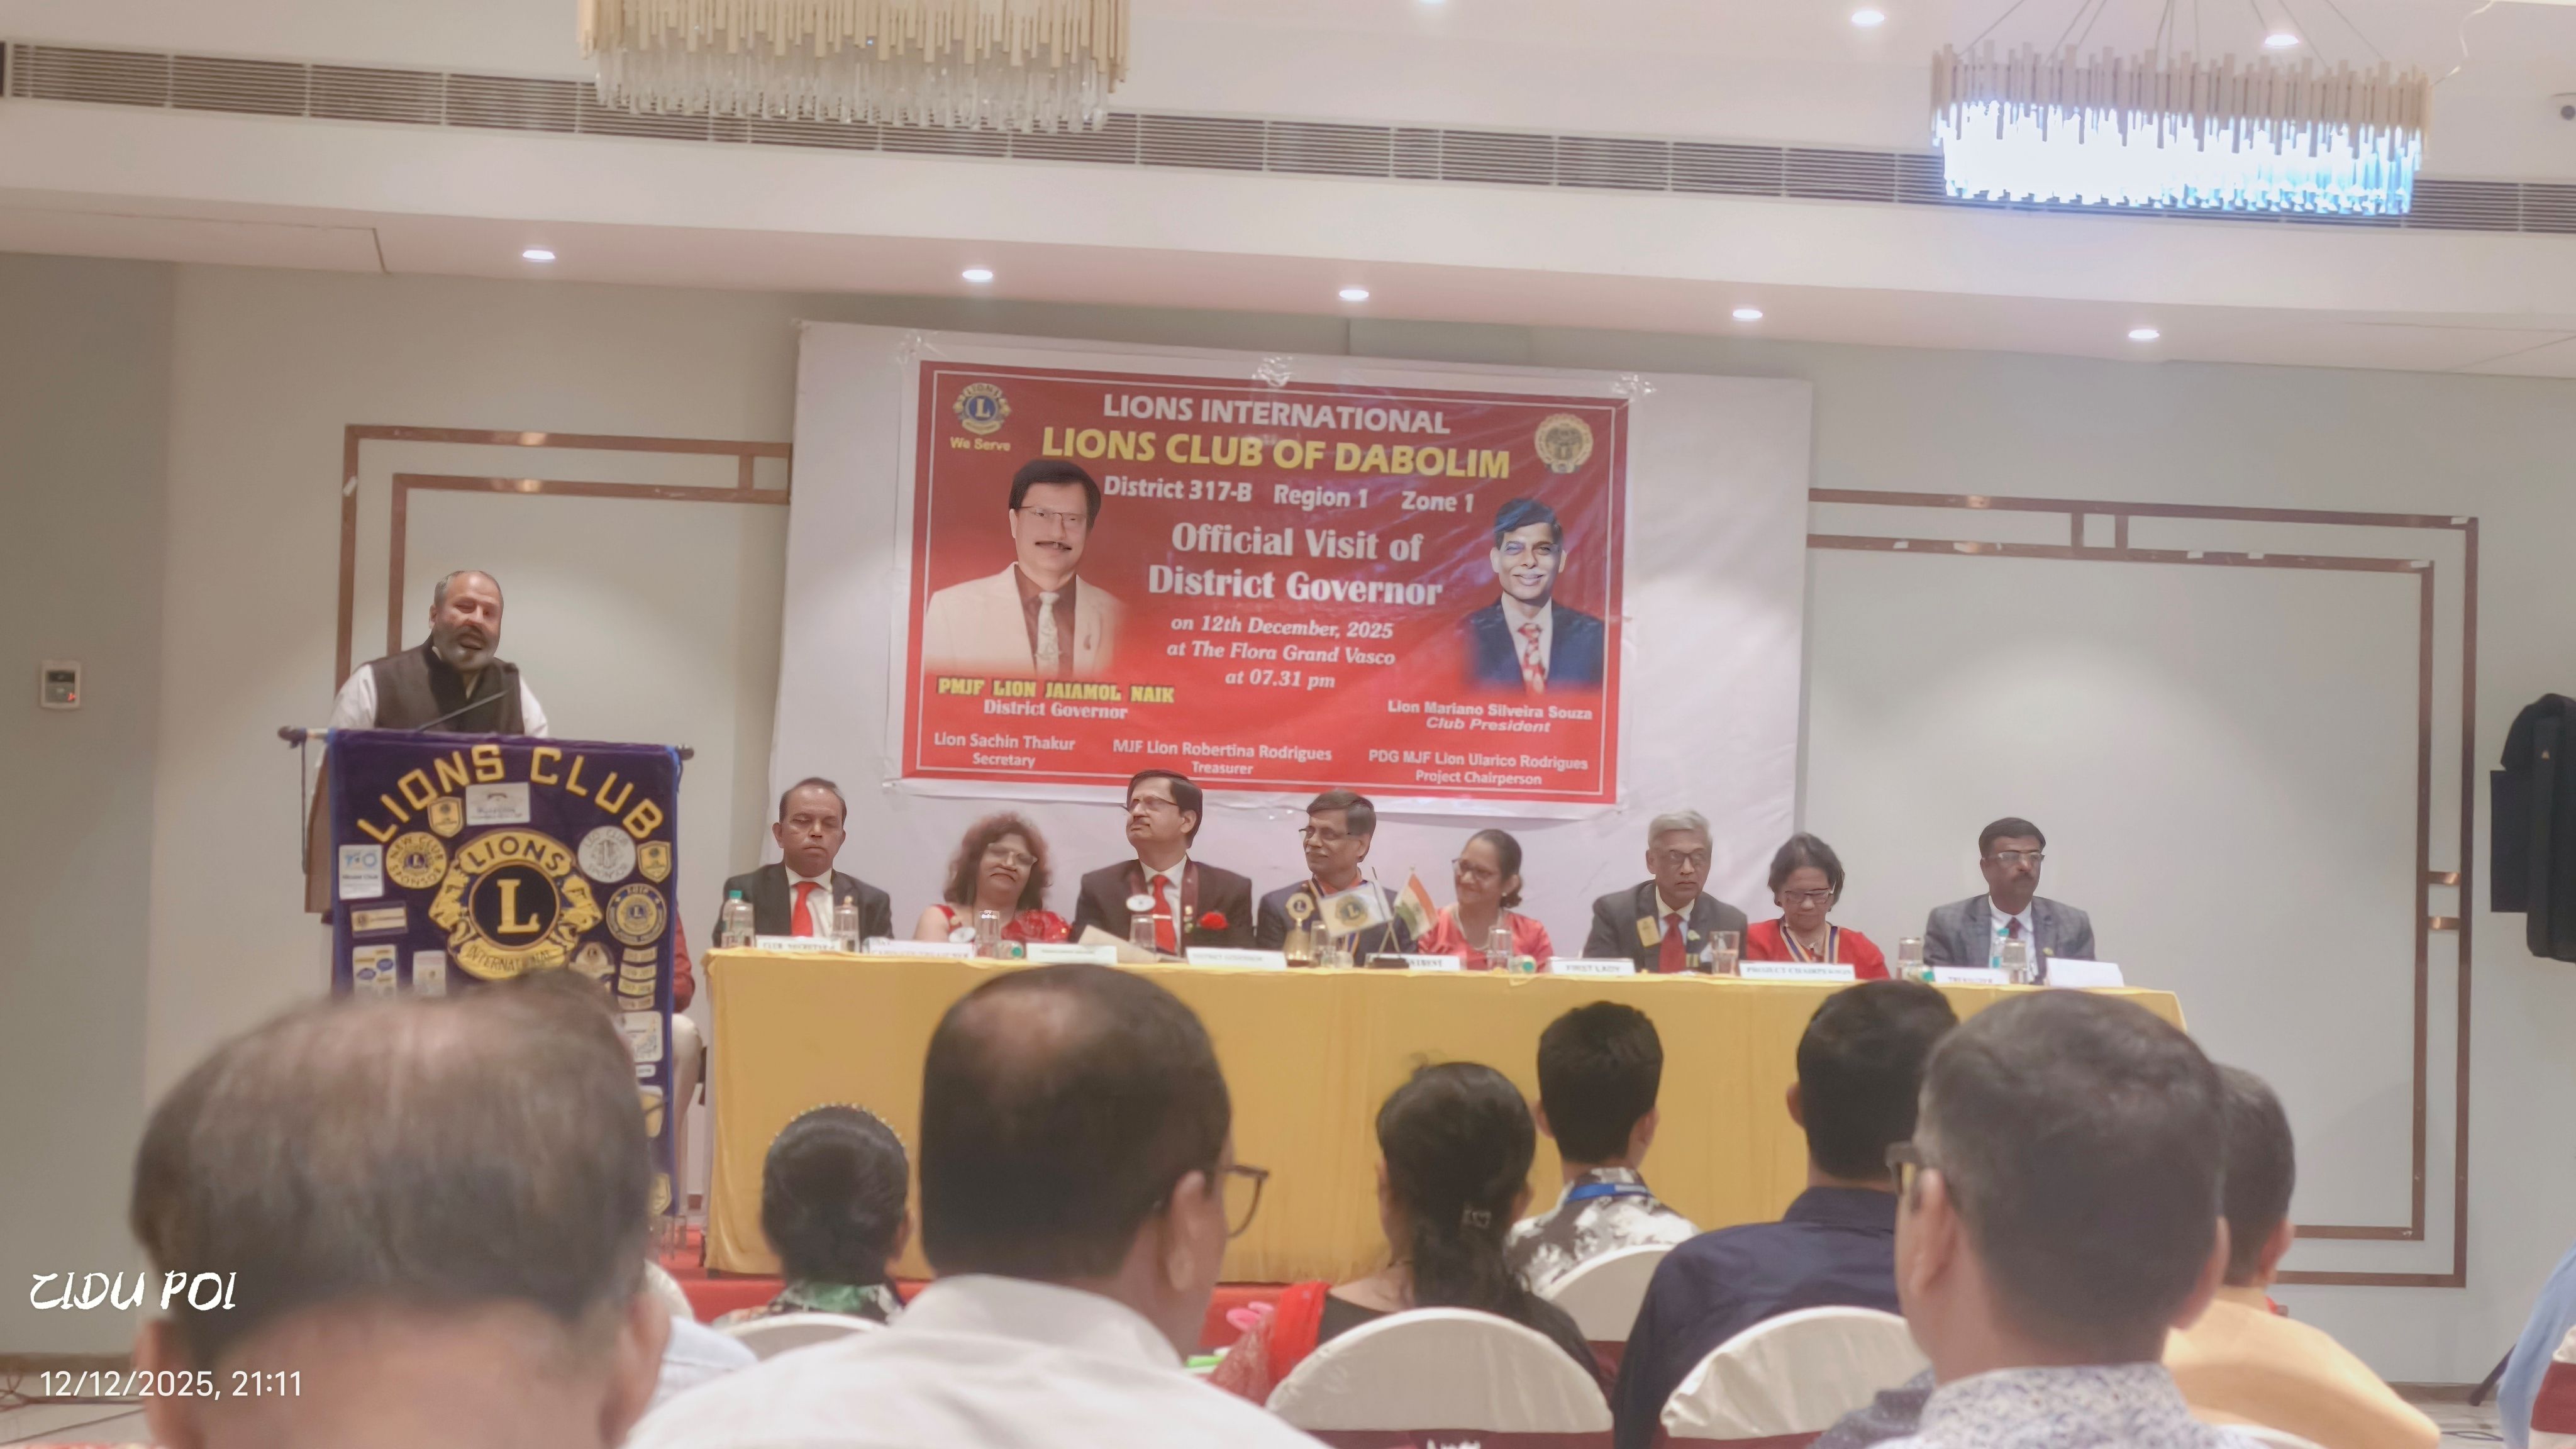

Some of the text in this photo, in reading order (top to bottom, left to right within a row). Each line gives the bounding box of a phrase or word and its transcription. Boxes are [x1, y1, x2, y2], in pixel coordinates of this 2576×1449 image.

[975, 398, 991, 417] L
[1104, 394, 1450, 434] LIONS INTERNATIONAL
[950, 436, 1010, 452] We Serve
[1042, 427, 1156, 461] LIONS
[1166, 433, 1263, 467] CLUB
[1273, 439, 1326, 470] OF
[1335, 442, 1509, 479] DABOLIM
[1104, 475, 1474, 513] District 317-B Region 1 Zone 1
[1172, 522, 1424, 562] Official Visit of
[1148, 565, 1443, 605] District Governor
[1171, 615, 1394, 639] on 12th December, 2025
[1167, 640, 1396, 665] at The Flora Grand Vasco
[937, 677, 1175, 703] PMJF LION JAIAMOL NAIK
[1224, 669, 1335, 691] at 07.31 pm
[984, 699, 1128, 719] District Governor
[1388, 700, 1592, 720] Lion Mariano Silveira Souza
[1426, 717, 1551, 733] Club President
[935, 733, 1075, 750] Lion Sachin Thakur
[1113, 740, 1332, 762] MJF Lion Robertina Rodrigues
[972, 752, 1035, 769] Secretary
[1192, 761, 1253, 775] Treasurer
[1368, 750, 1588, 772] PDG MJF Lion Ularico Rodrigues
[1416, 770, 1542, 786] Project Chairperson
[357, 744, 663, 842] LIONS CLUB
[467, 836, 565, 871] LIONS
[497, 879, 540, 934] L
